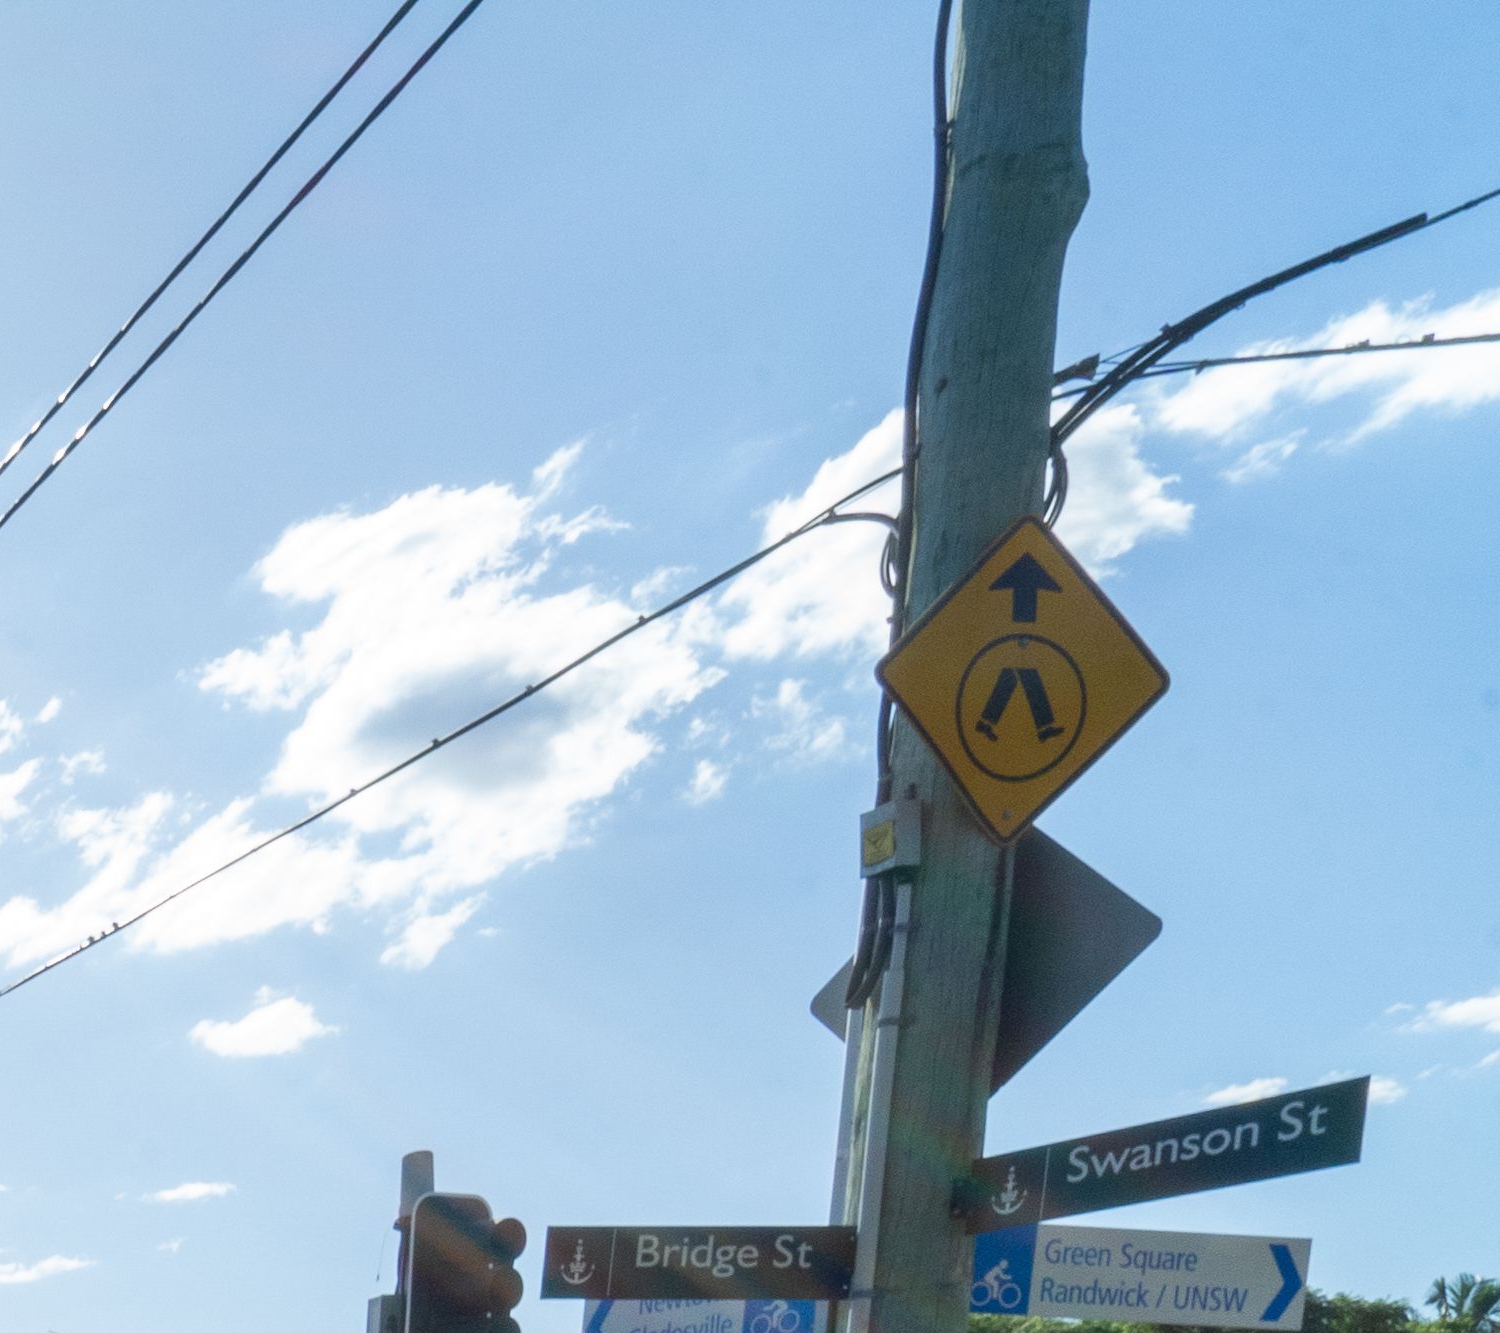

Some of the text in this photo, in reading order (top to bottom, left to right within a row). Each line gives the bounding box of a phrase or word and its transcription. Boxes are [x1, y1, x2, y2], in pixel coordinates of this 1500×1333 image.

[1066, 1100, 1329, 1183] Swanson St
[635, 1233, 814, 1278] Bridge St
[1044, 1238, 1199, 1272] Green Square
[1039, 1279, 1249, 1312] Randwick / UNSW
